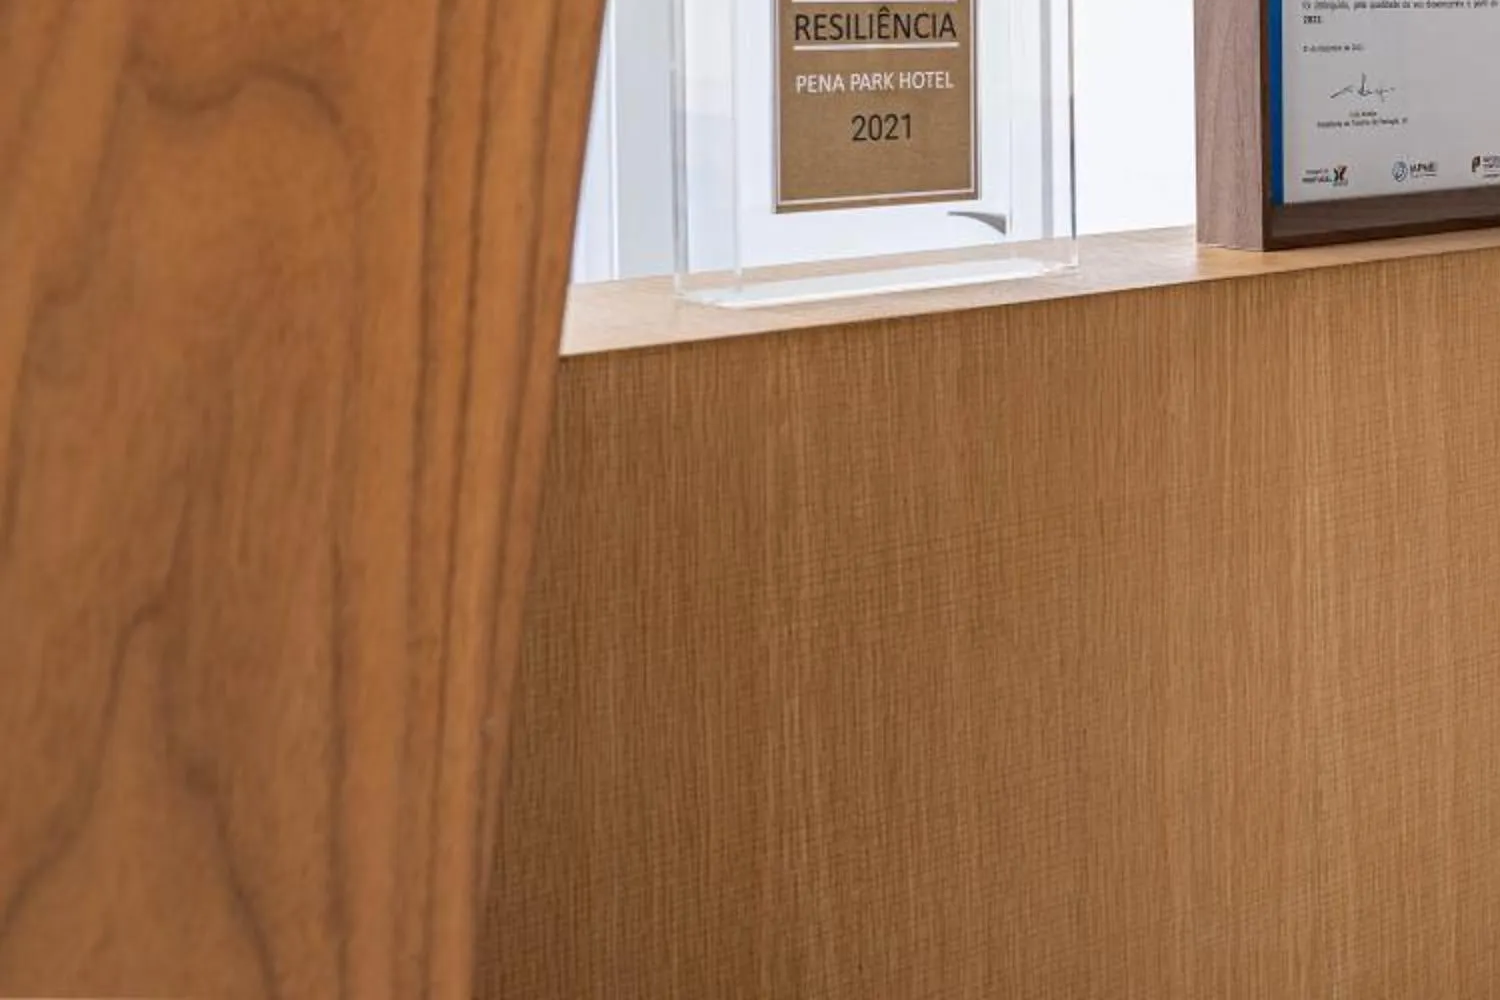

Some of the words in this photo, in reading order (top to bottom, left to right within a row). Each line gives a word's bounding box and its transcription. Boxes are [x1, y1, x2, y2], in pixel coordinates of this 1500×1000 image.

[794, 6, 957, 41] RESILIÊNCIA
[796, 73, 845, 93] PENA
[850, 72, 894, 92] PARK
[899, 70, 955, 91] HOTEL
[851, 113, 913, 142] 2021
